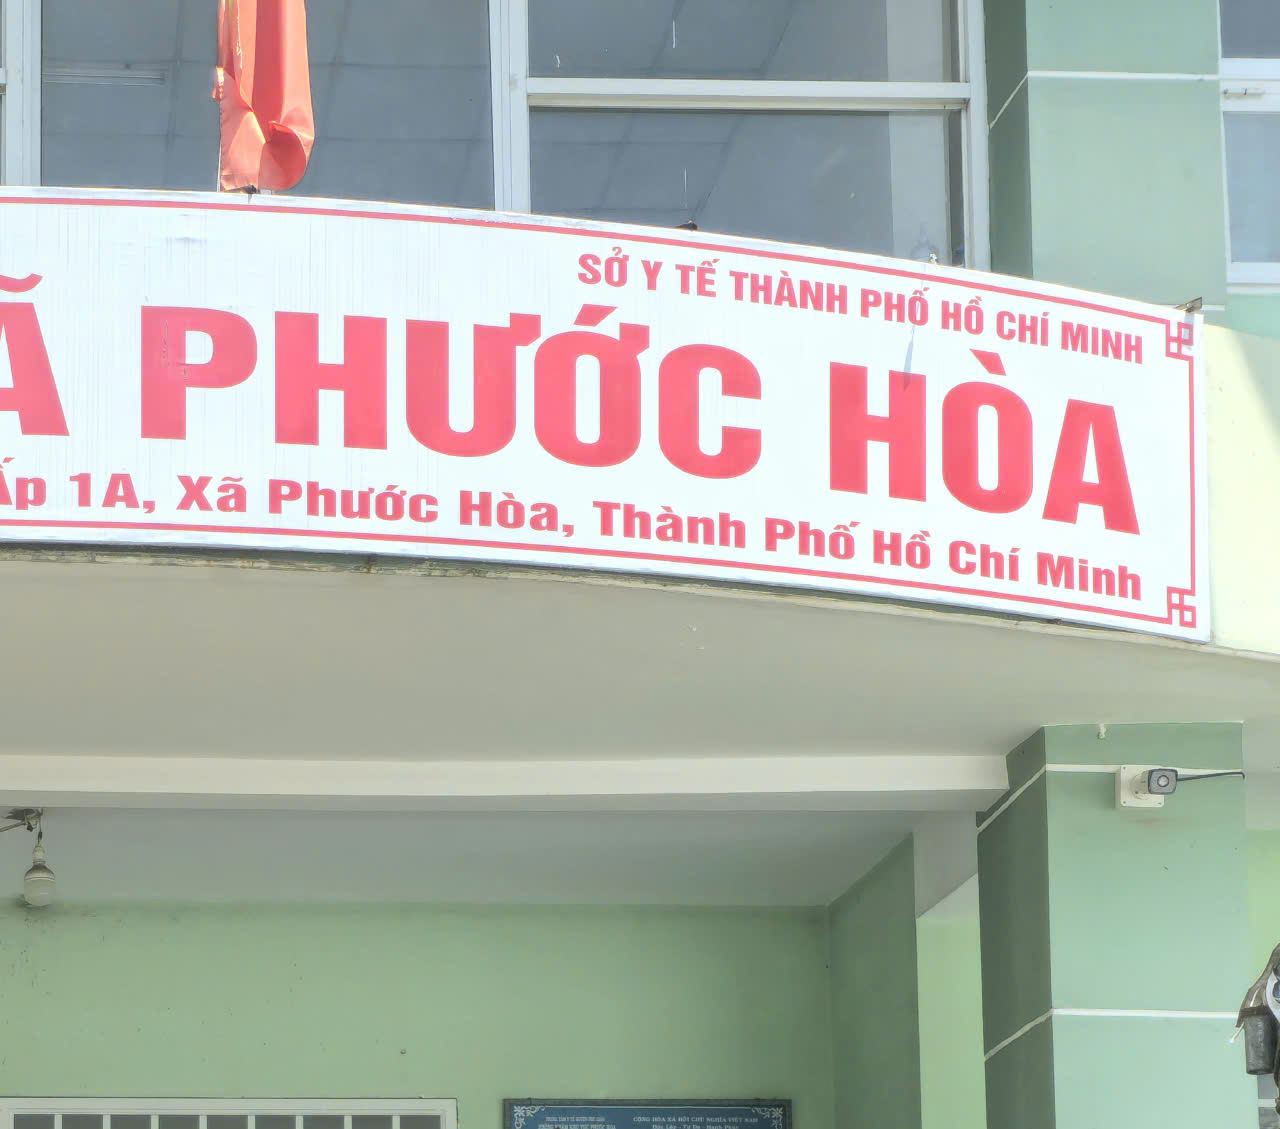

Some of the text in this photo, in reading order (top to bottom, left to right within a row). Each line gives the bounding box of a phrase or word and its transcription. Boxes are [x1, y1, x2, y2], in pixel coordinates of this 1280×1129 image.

[578, 246, 1143, 365] SỞ Y TẾ THÀNH PHỐ HỒ CHÍ MINH
[140, 303, 763, 480] PHƯỚC
[829, 348, 1141, 535] HÒA
[69, 472, 156, 514] 1A,
[176, 474, 247, 513] Xã
[268, 478, 439, 523] Phước
[460, 490, 575, 537] Hòa,
[593, 500, 746, 549] Thành
[765, 516, 861, 560] Phố
[873, 528, 931, 570] Hồ
[948, 540, 1021, 582] Chí
[1036, 551, 1142, 601] Minh
